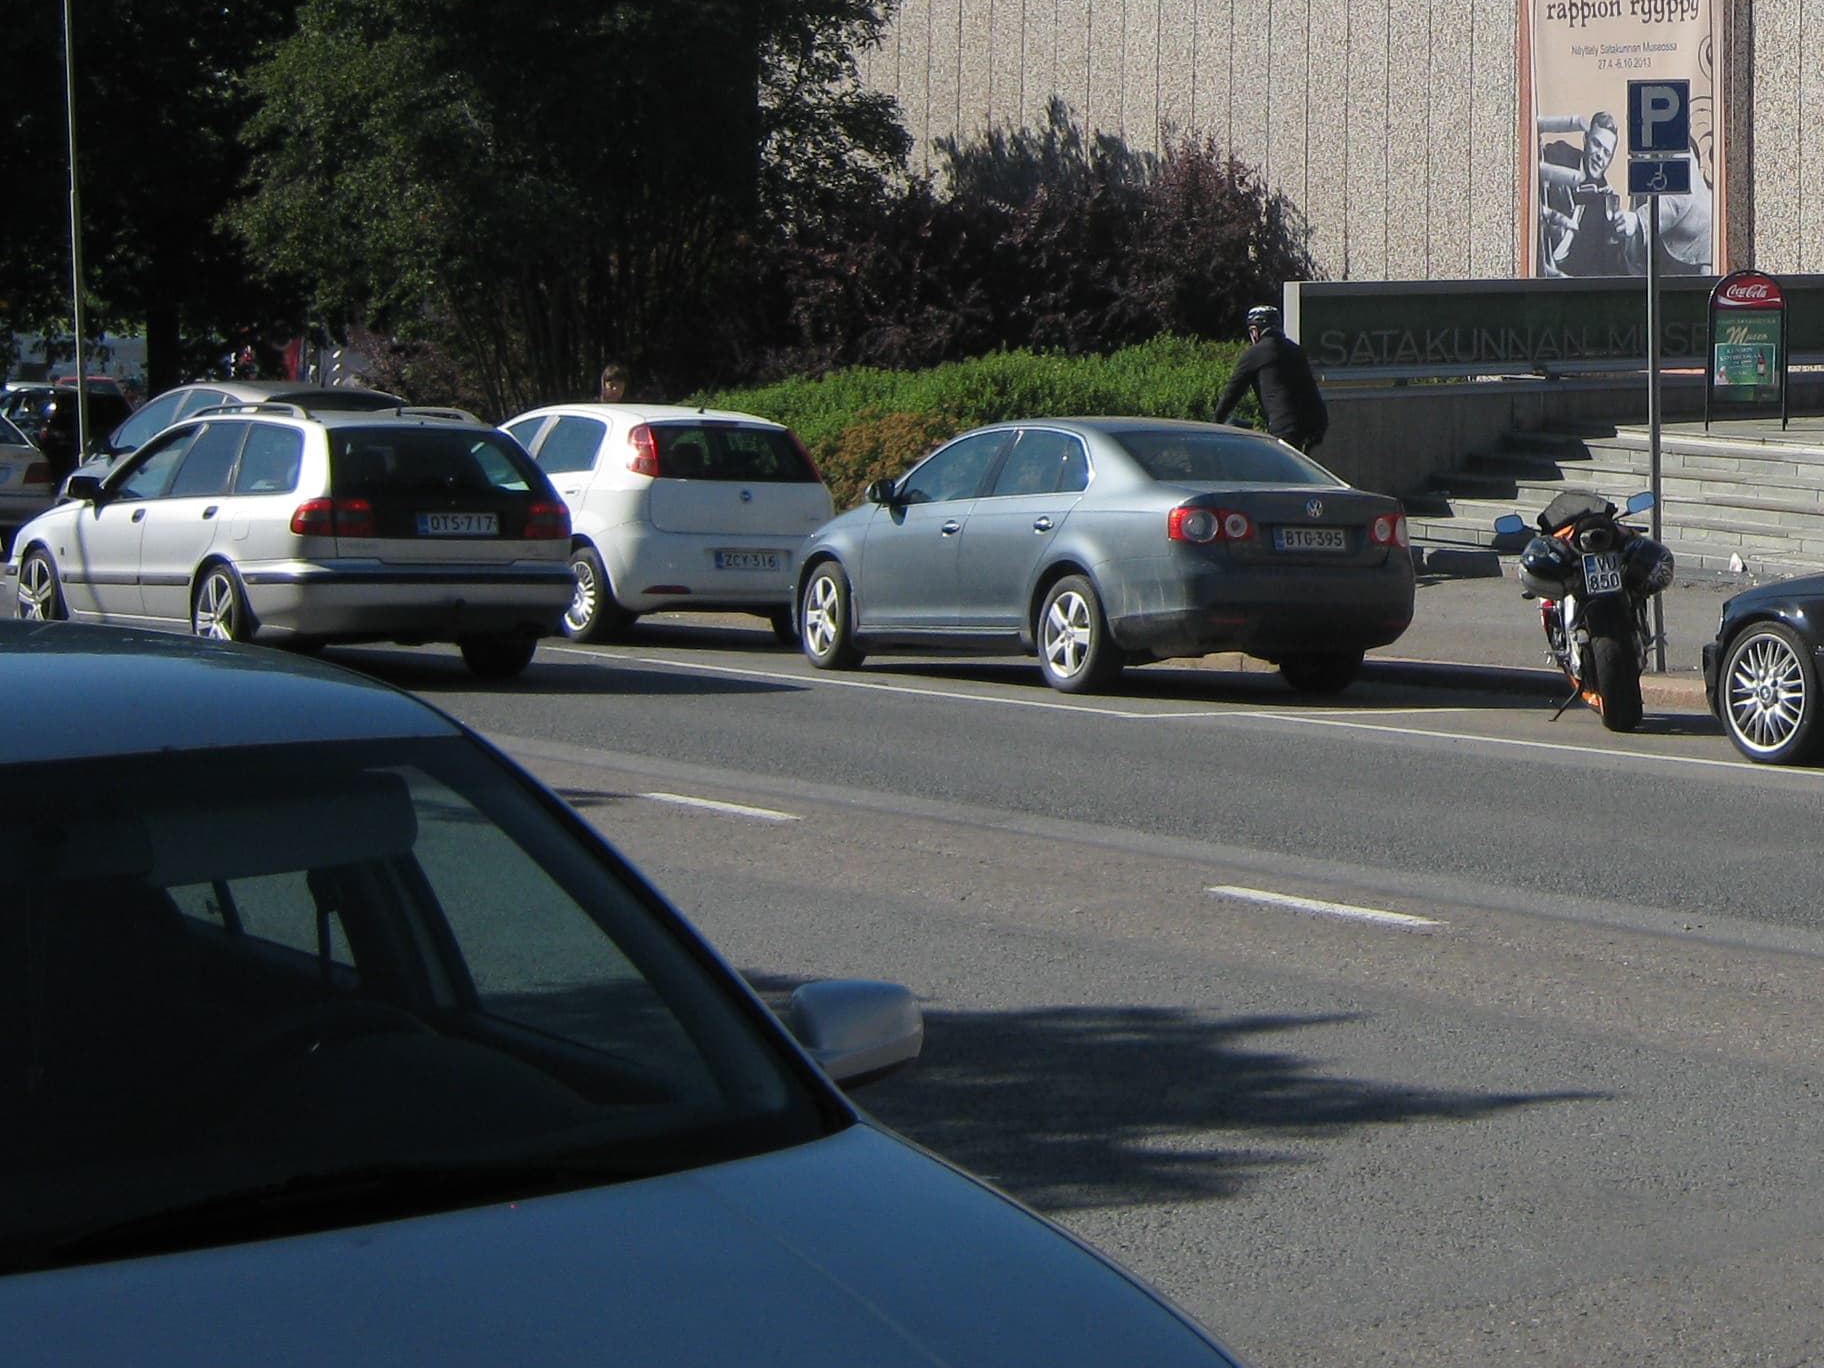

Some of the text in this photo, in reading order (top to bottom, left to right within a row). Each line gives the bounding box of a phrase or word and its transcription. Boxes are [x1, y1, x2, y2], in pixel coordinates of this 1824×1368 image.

[1640, 85, 1680, 148] P
[1319, 326, 1589, 367] SATAKUNNAN
[1590, 572, 1620, 590] 850
